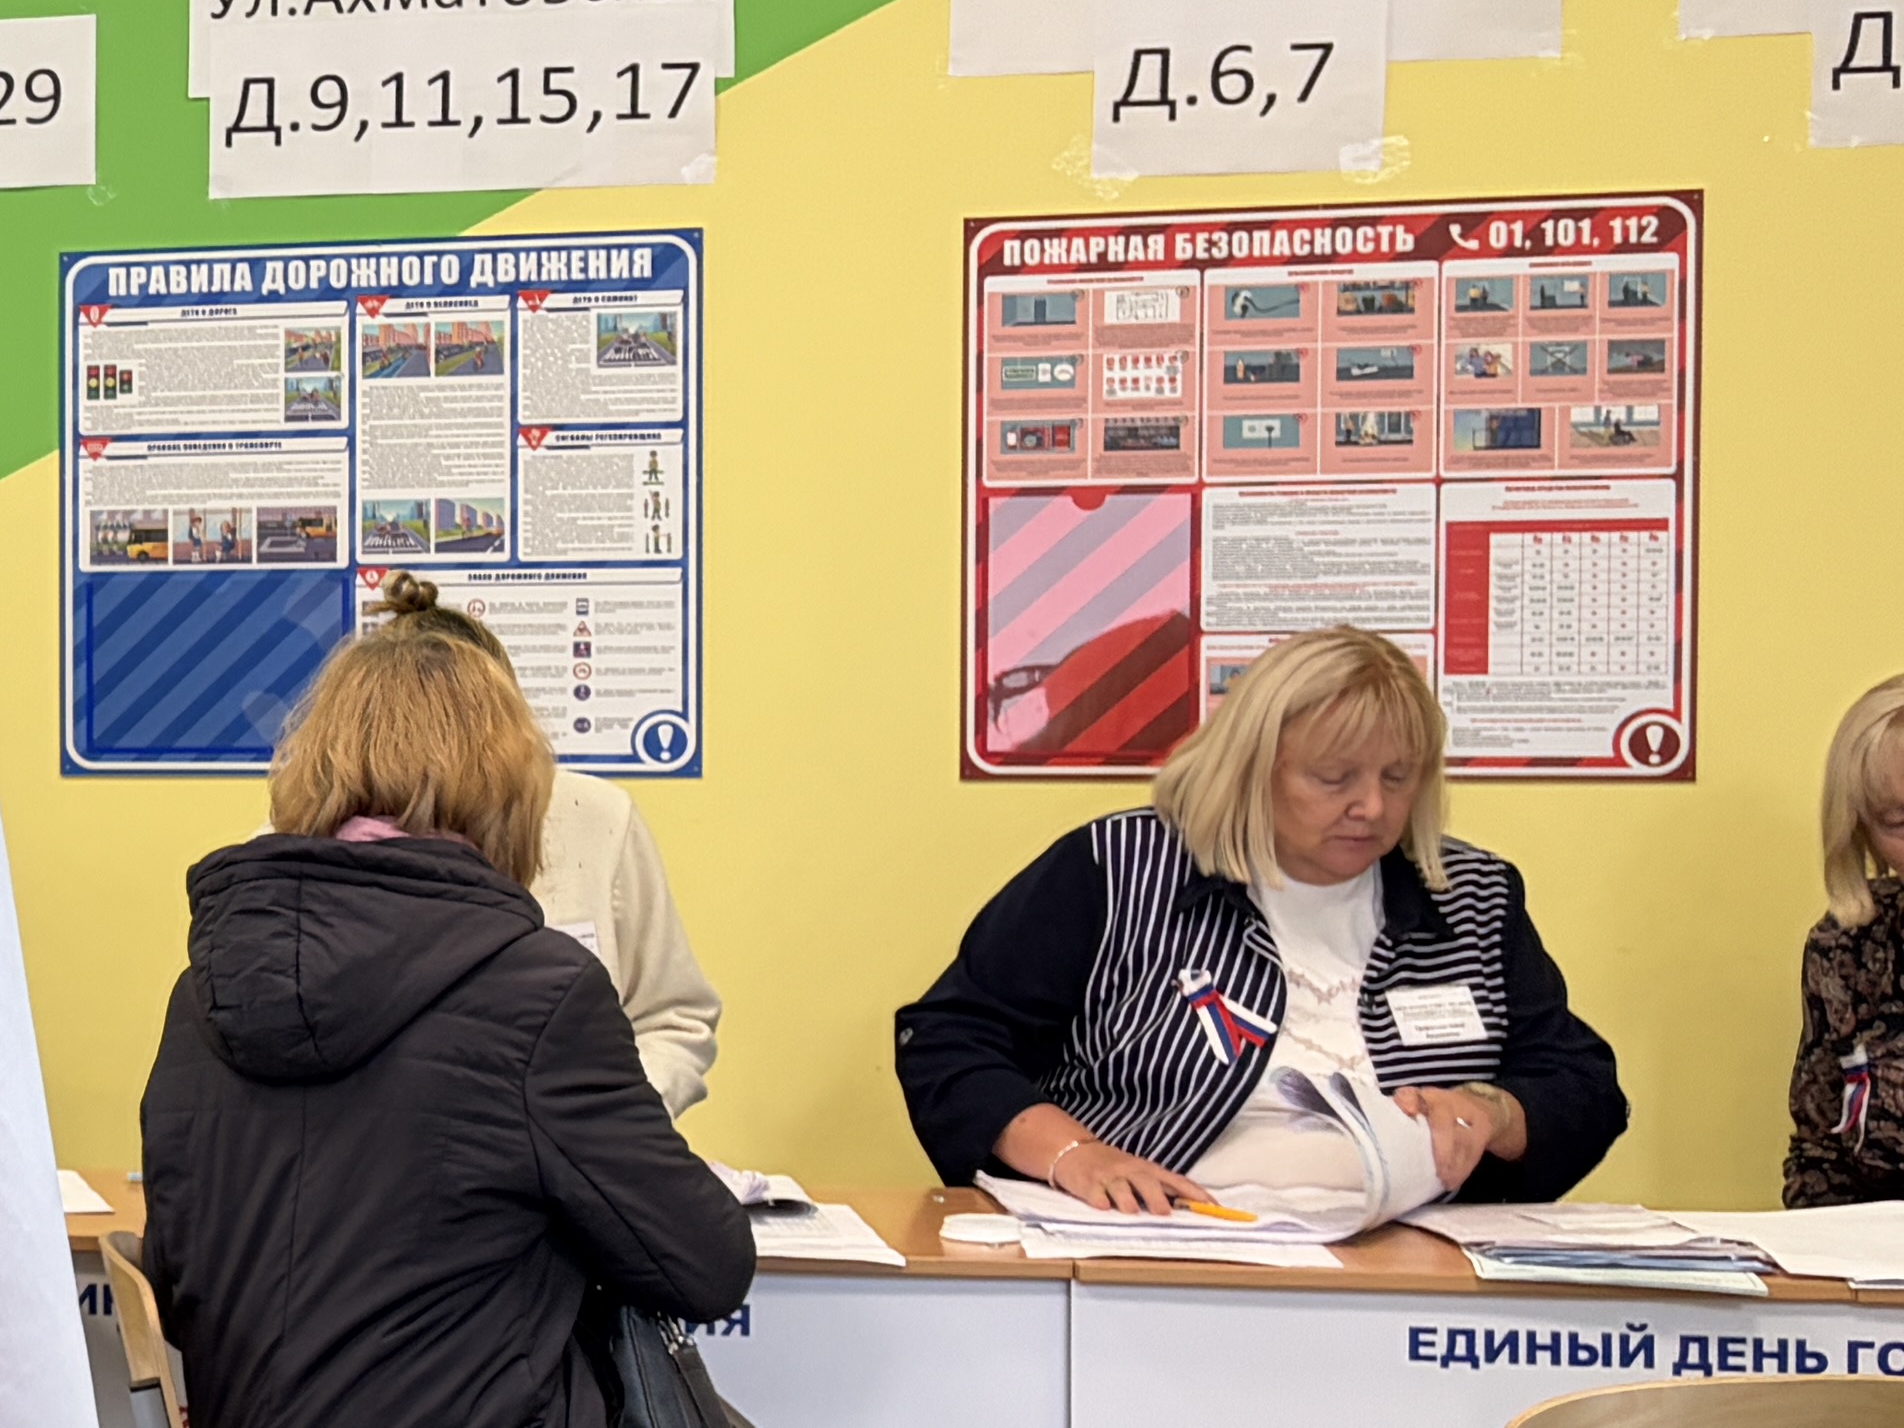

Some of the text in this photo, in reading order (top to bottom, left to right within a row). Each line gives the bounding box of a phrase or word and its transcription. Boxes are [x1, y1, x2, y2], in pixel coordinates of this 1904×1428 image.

[225, 60, 703, 149] Д.9,11,15,17
[1111, 40, 1335, 123] Д.6,7
[1002, 216, 1659, 267] ПОЖАРНАЯ БЕЗОПАСНОСТЬ 01, 101, 112
[107, 247, 654, 297] ПРАВИЛА ДОРОЖНОГО ДВИЖЕНИЯ
[1408, 1322, 1656, 1370] ЕДИНЫЙ
[1672, 1334, 1828, 1376] ДЕНЬ
